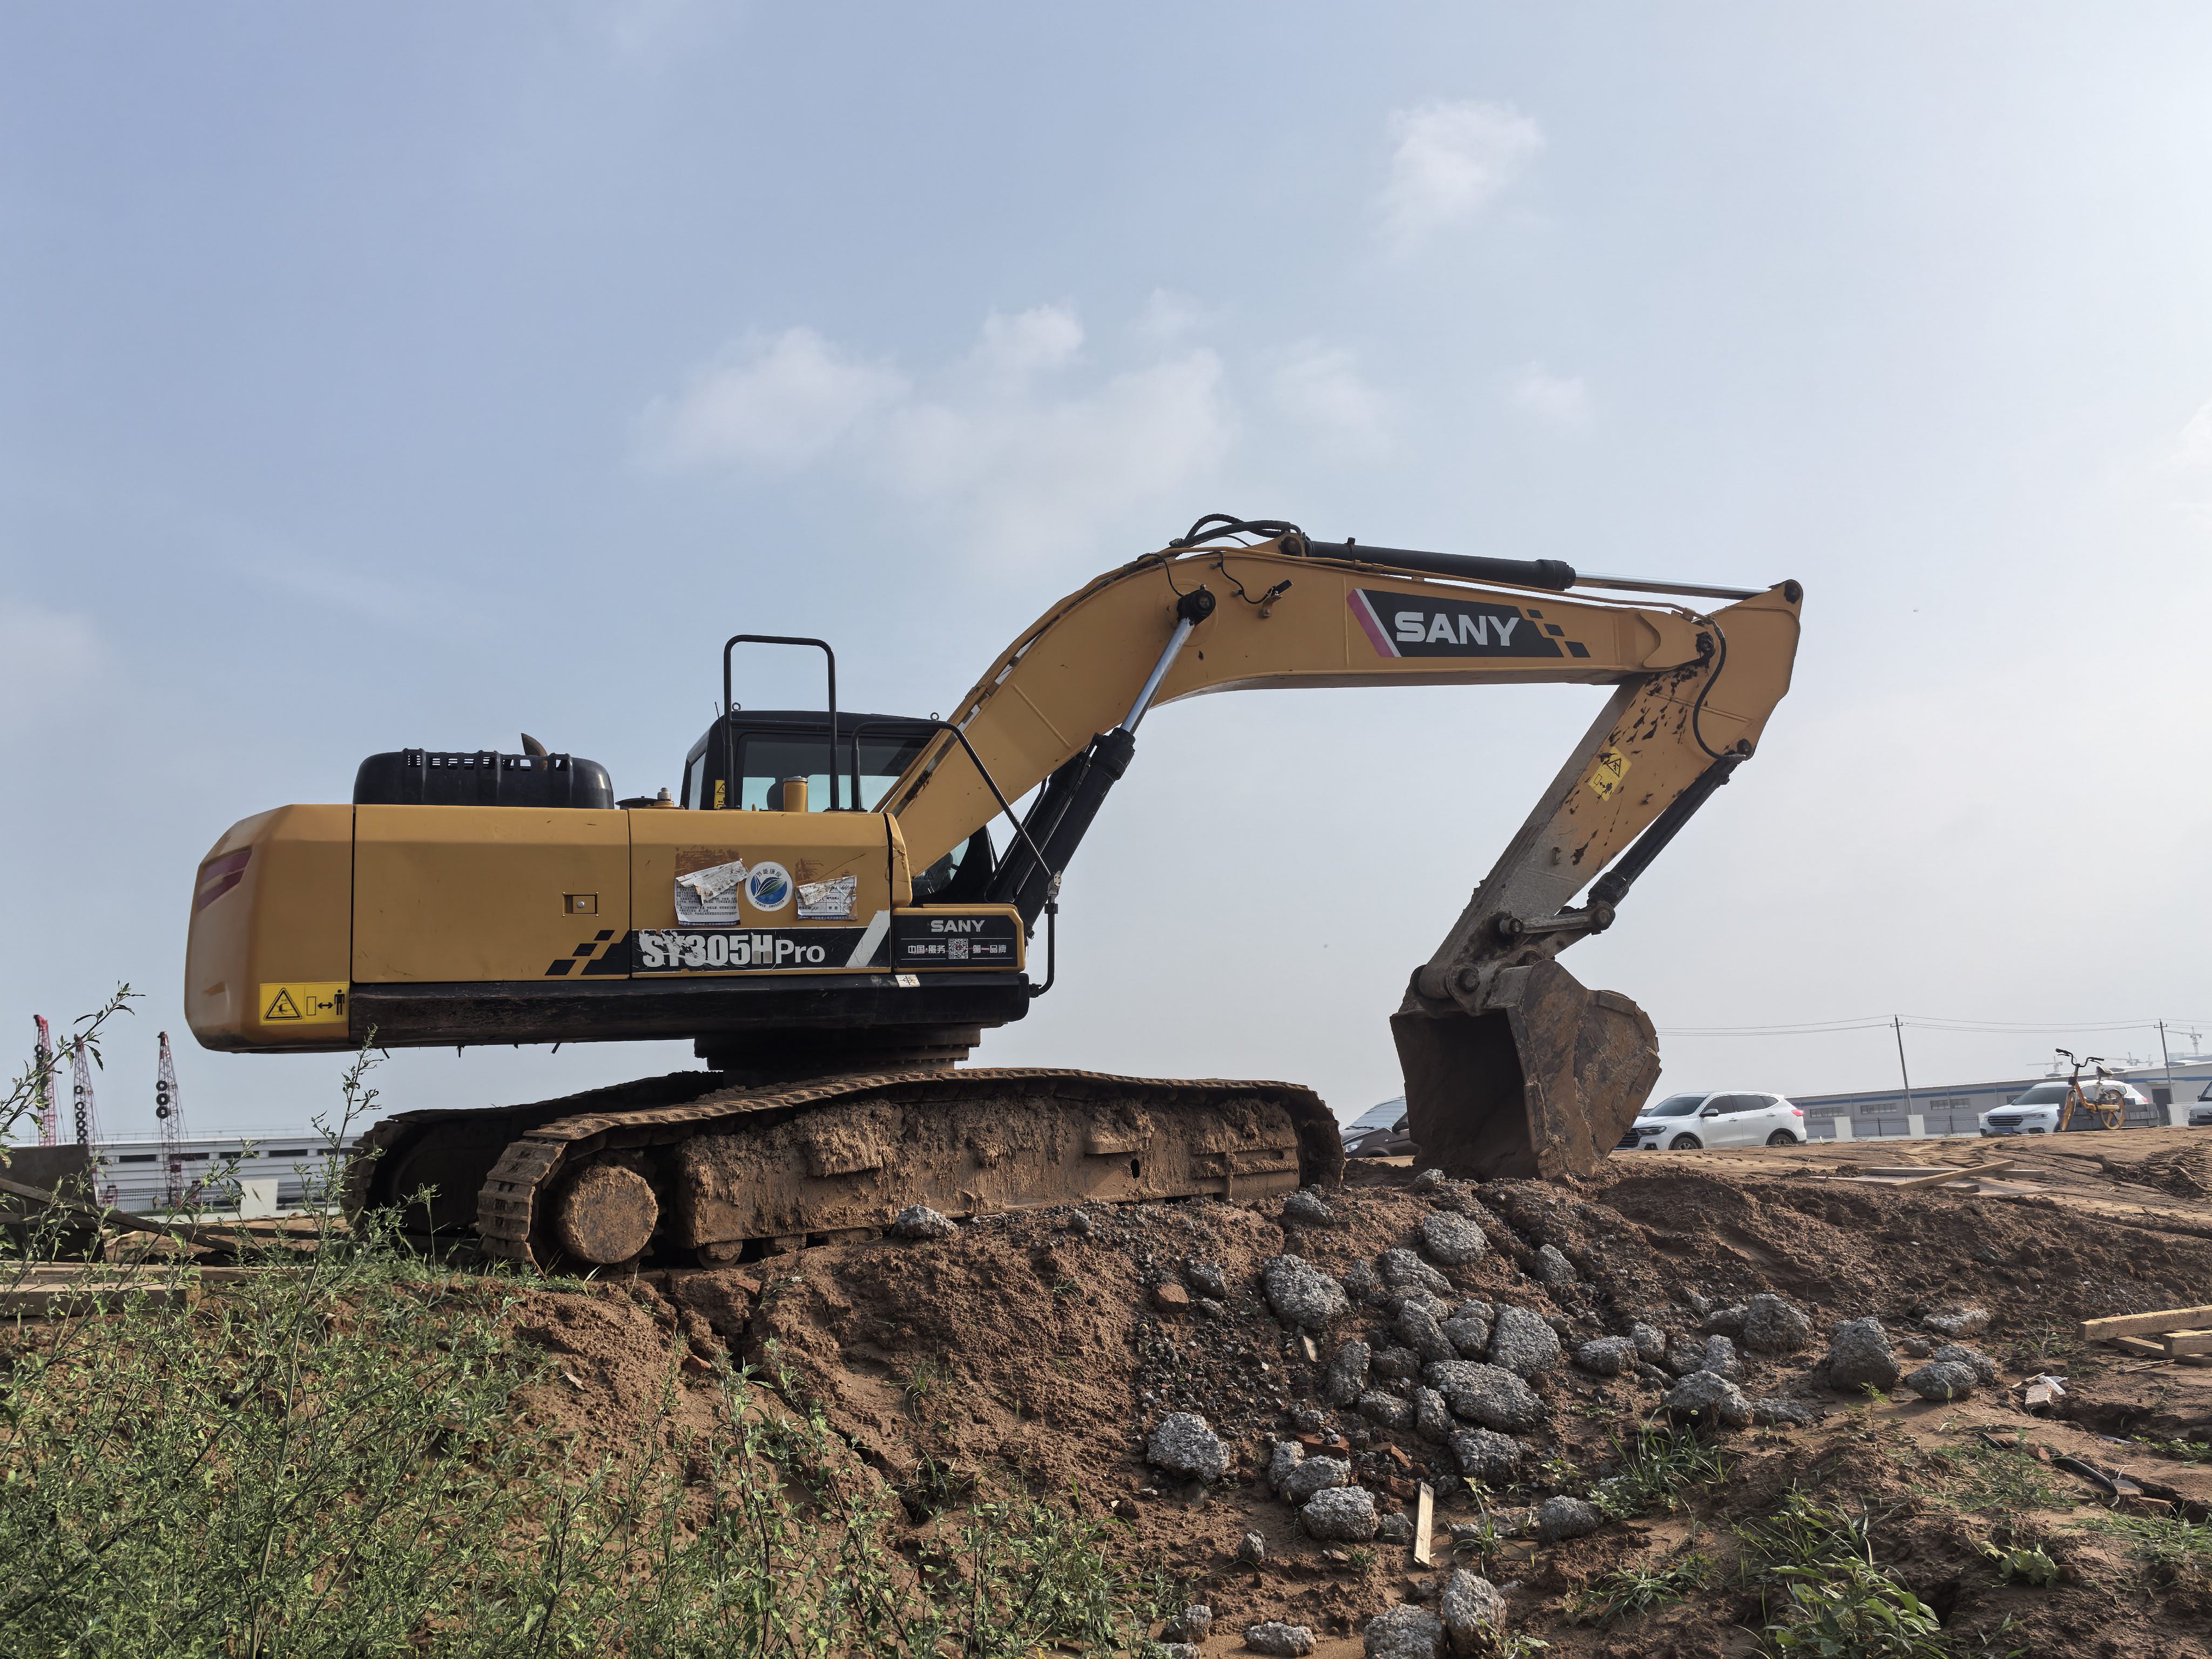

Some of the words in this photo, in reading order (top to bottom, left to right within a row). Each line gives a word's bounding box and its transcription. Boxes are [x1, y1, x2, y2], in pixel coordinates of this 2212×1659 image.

[1394, 611, 1520, 646] SANY
[930, 920, 986, 932] SANY
[973, 945, 1007, 954] 第一品牌
